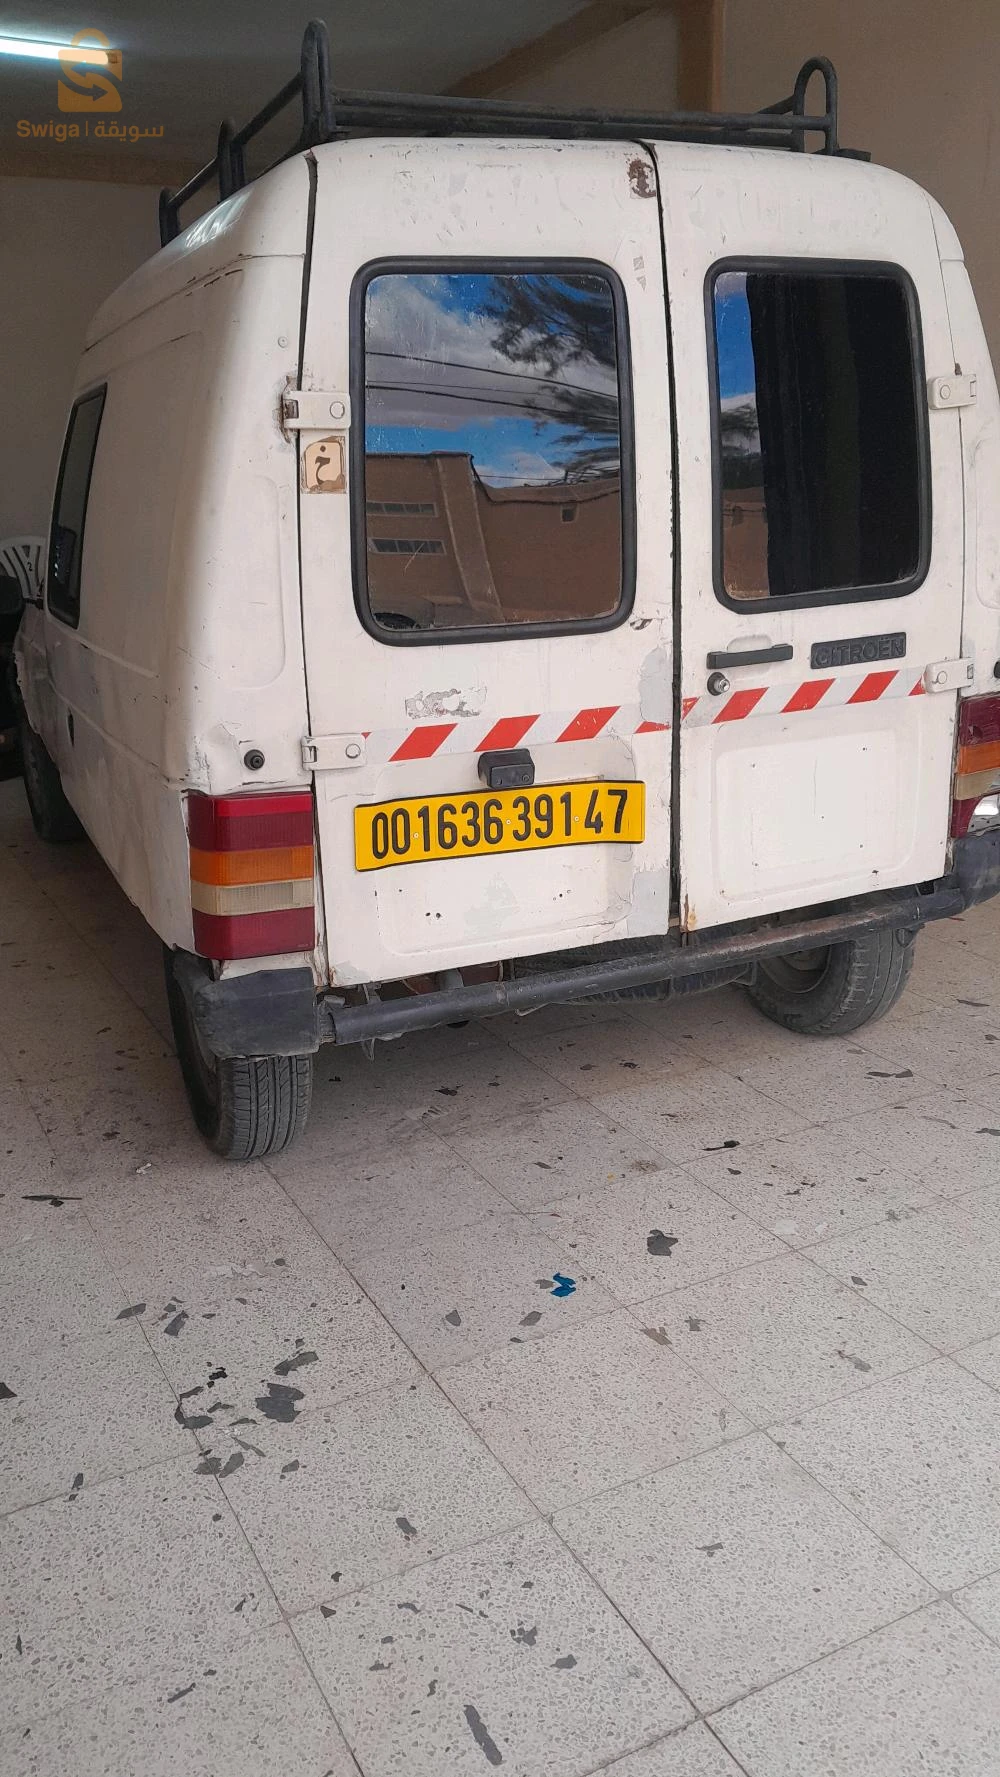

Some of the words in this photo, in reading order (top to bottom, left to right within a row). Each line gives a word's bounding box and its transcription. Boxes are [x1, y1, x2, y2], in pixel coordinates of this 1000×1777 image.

[815, 637, 904, 667] CITROËN
[371, 799, 504, 860] 001636
[512, 791, 572, 842] 391
[584, 789, 628, 834] 47
